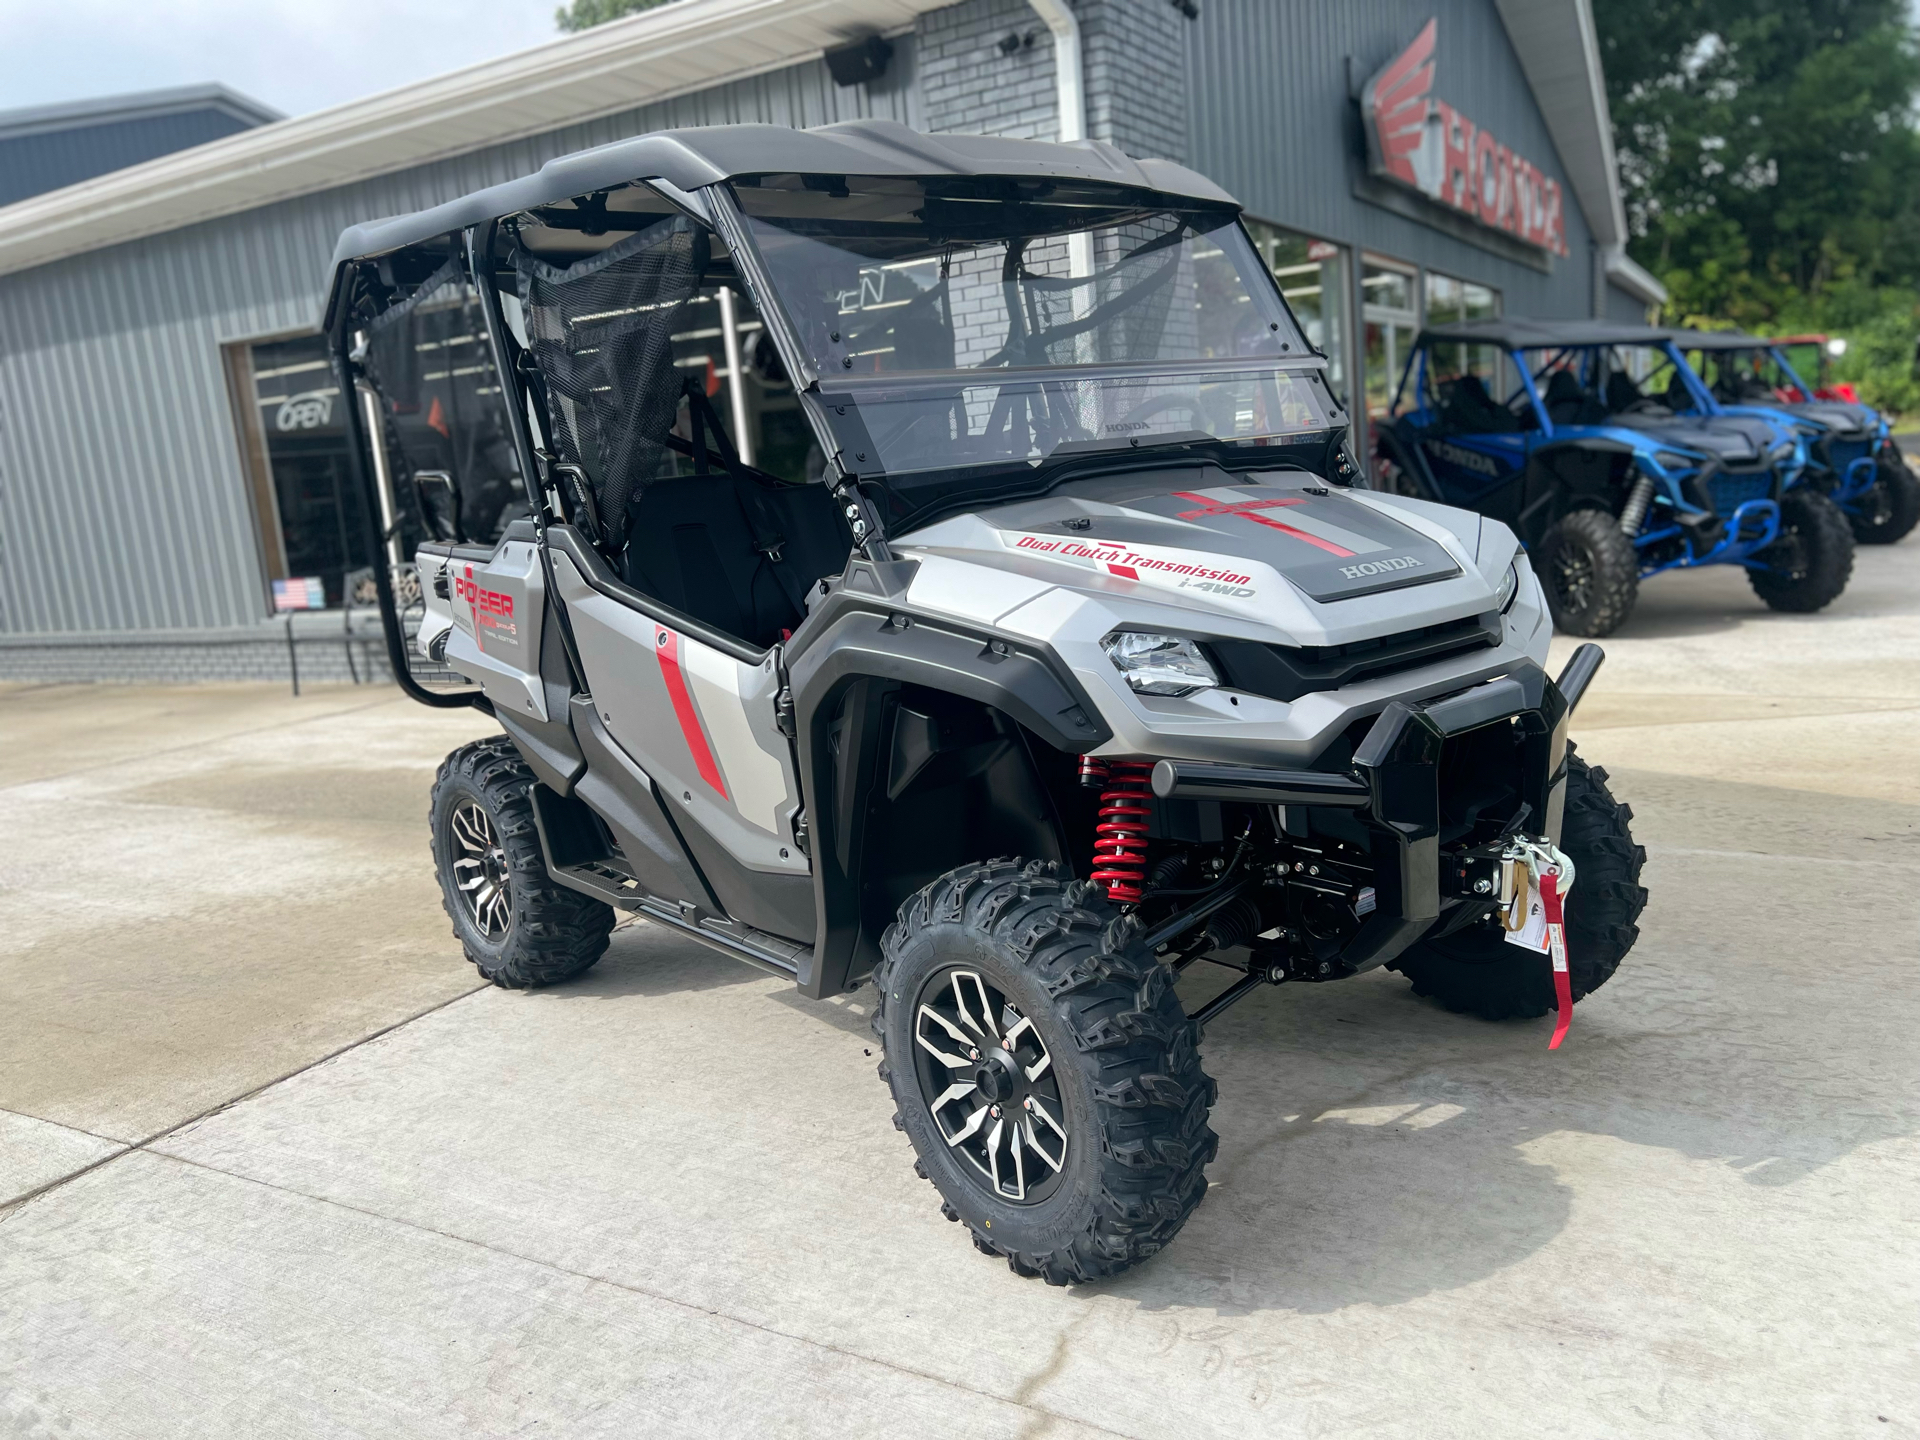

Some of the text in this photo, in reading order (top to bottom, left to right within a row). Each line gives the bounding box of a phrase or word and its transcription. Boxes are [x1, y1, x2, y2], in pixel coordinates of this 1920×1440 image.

[1438, 98, 1570, 259] HONDA
[276, 393, 332, 431] OPEN
[1105, 421, 1151, 433] HONDA
[1016, 536, 1252, 585] Dual Clutch Transmission
[1338, 556, 1425, 580] HONDA
[1177, 577, 1257, 599] i-4WD
